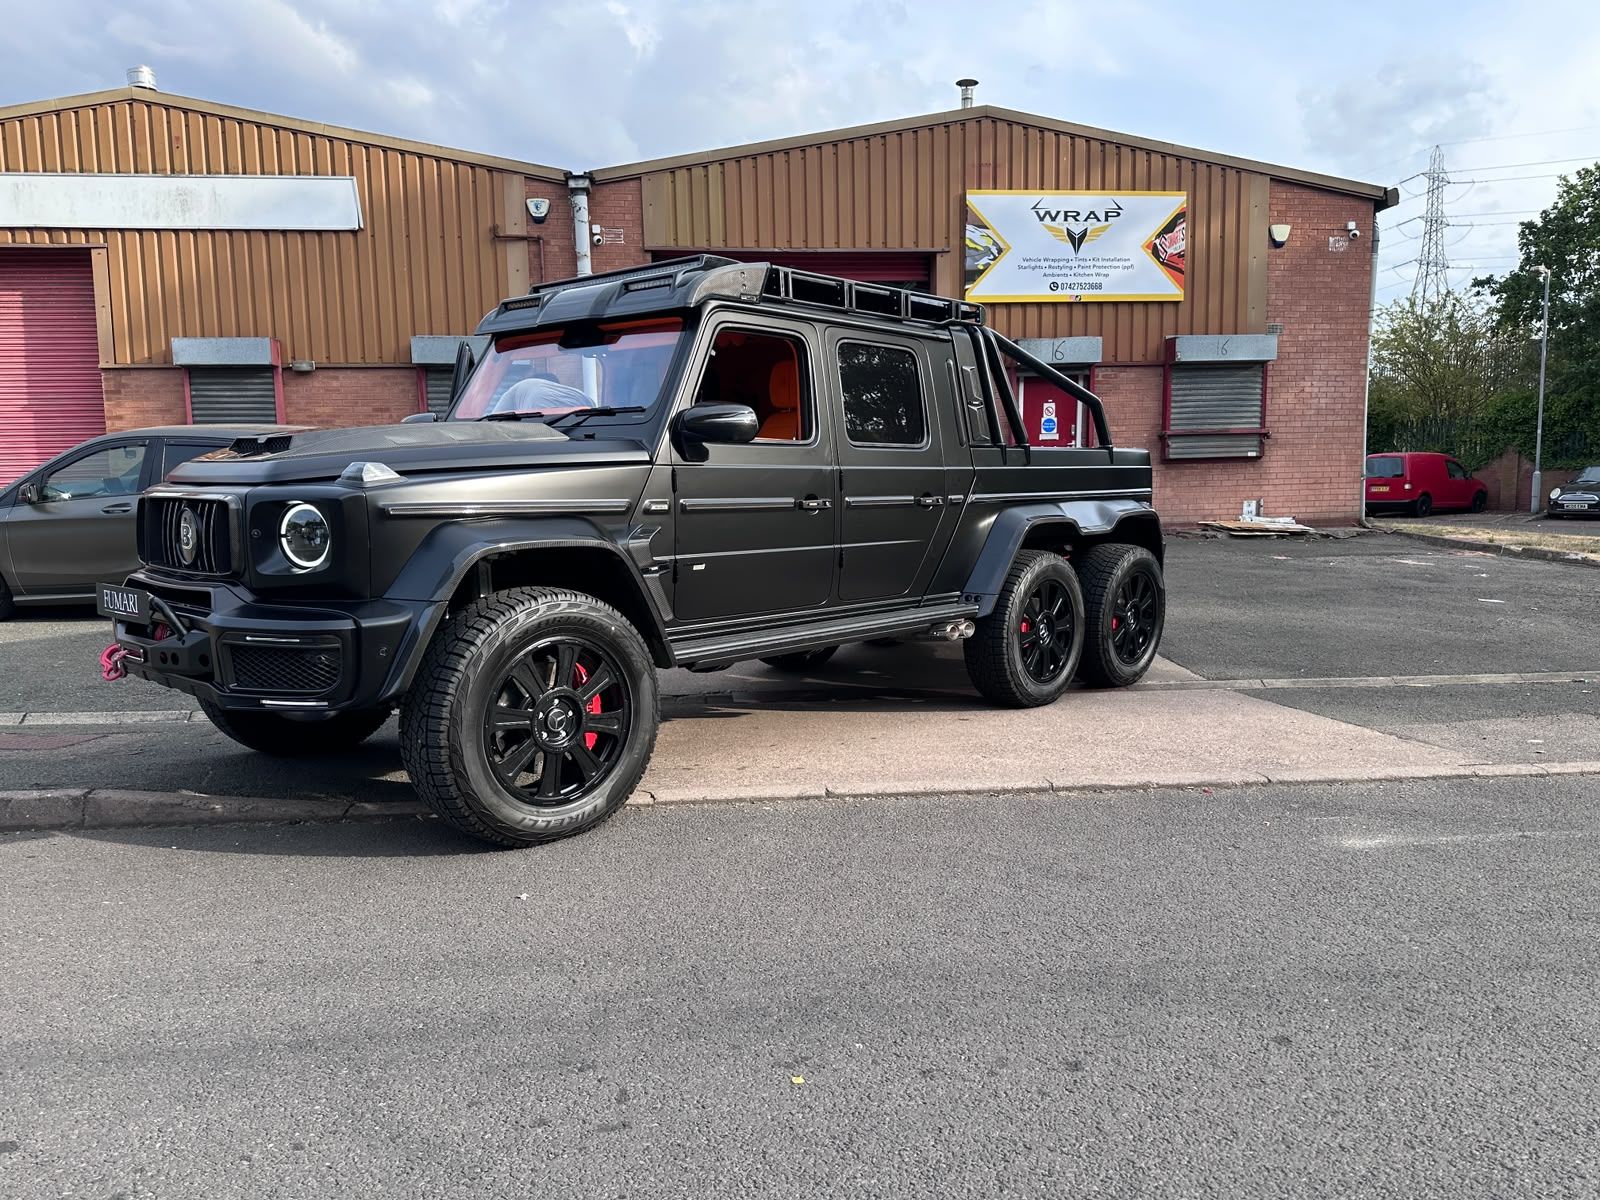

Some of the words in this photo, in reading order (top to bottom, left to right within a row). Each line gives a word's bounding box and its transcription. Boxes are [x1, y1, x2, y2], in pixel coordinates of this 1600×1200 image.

[1034, 210, 1121, 222] WRAP
[1060, 282, 1103, 291] 07427523668
[1051, 340, 1066, 361] 16
[1216, 338, 1230, 357] 16
[181, 523, 193, 550] B
[103, 589, 139, 614] FUMARI
[515, 803, 599, 830] PIRELLI
